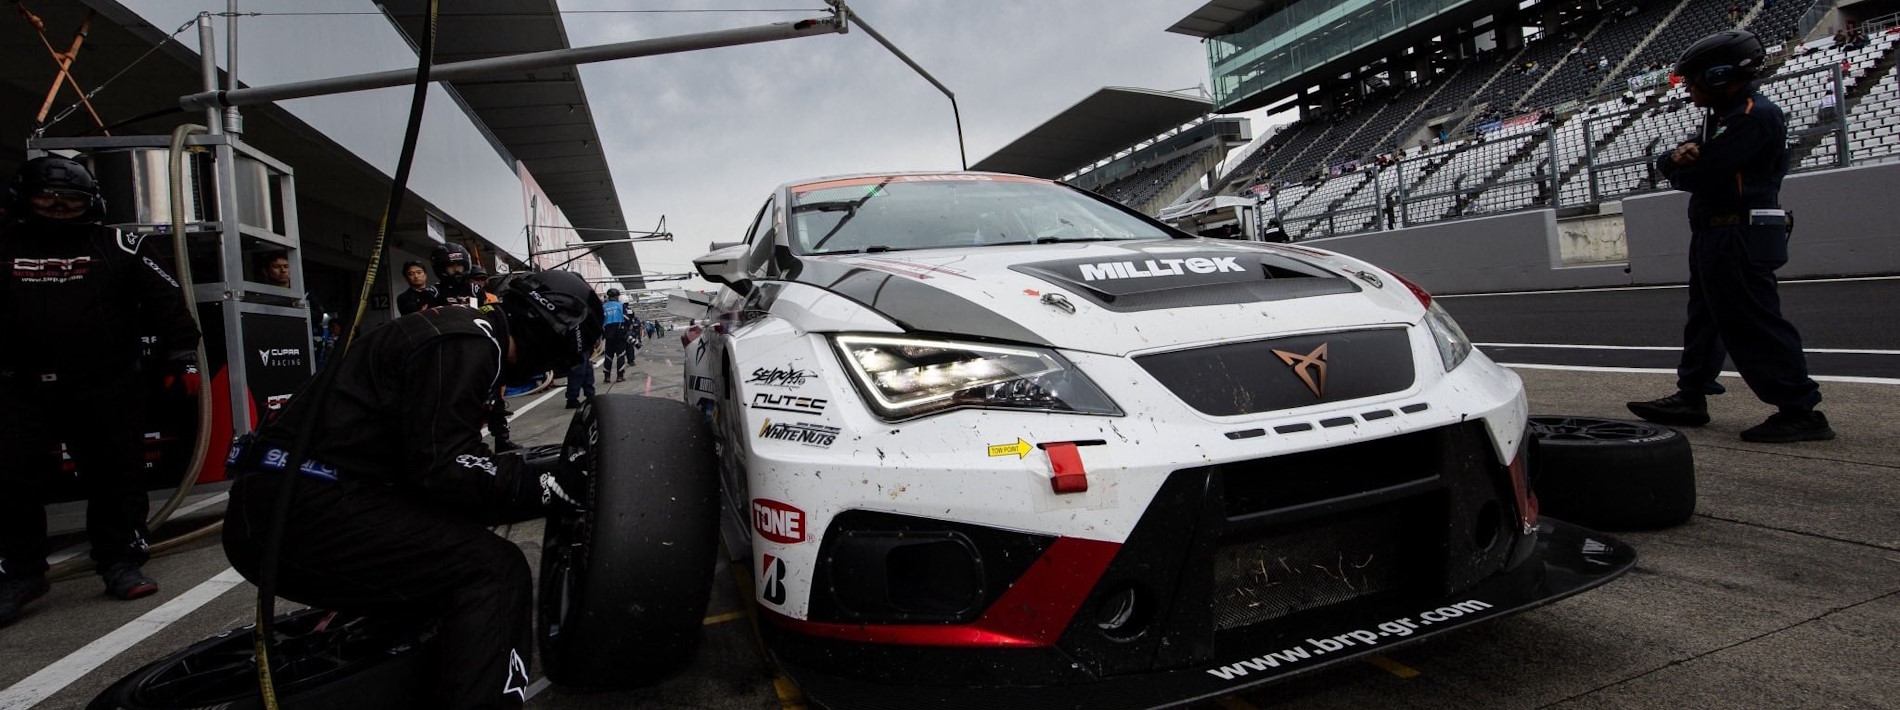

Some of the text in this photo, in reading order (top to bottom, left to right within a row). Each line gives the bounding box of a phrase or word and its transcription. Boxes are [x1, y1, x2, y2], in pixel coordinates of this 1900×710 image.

[373, 295, 389, 309] 12
[271, 348, 300, 356] CUPRA
[271, 359, 301, 367] RACING
[991, 445, 1019, 455] TOW POINT
[753, 502, 801, 540] TONE
[1206, 599, 1494, 680] www.brp.gr.com
